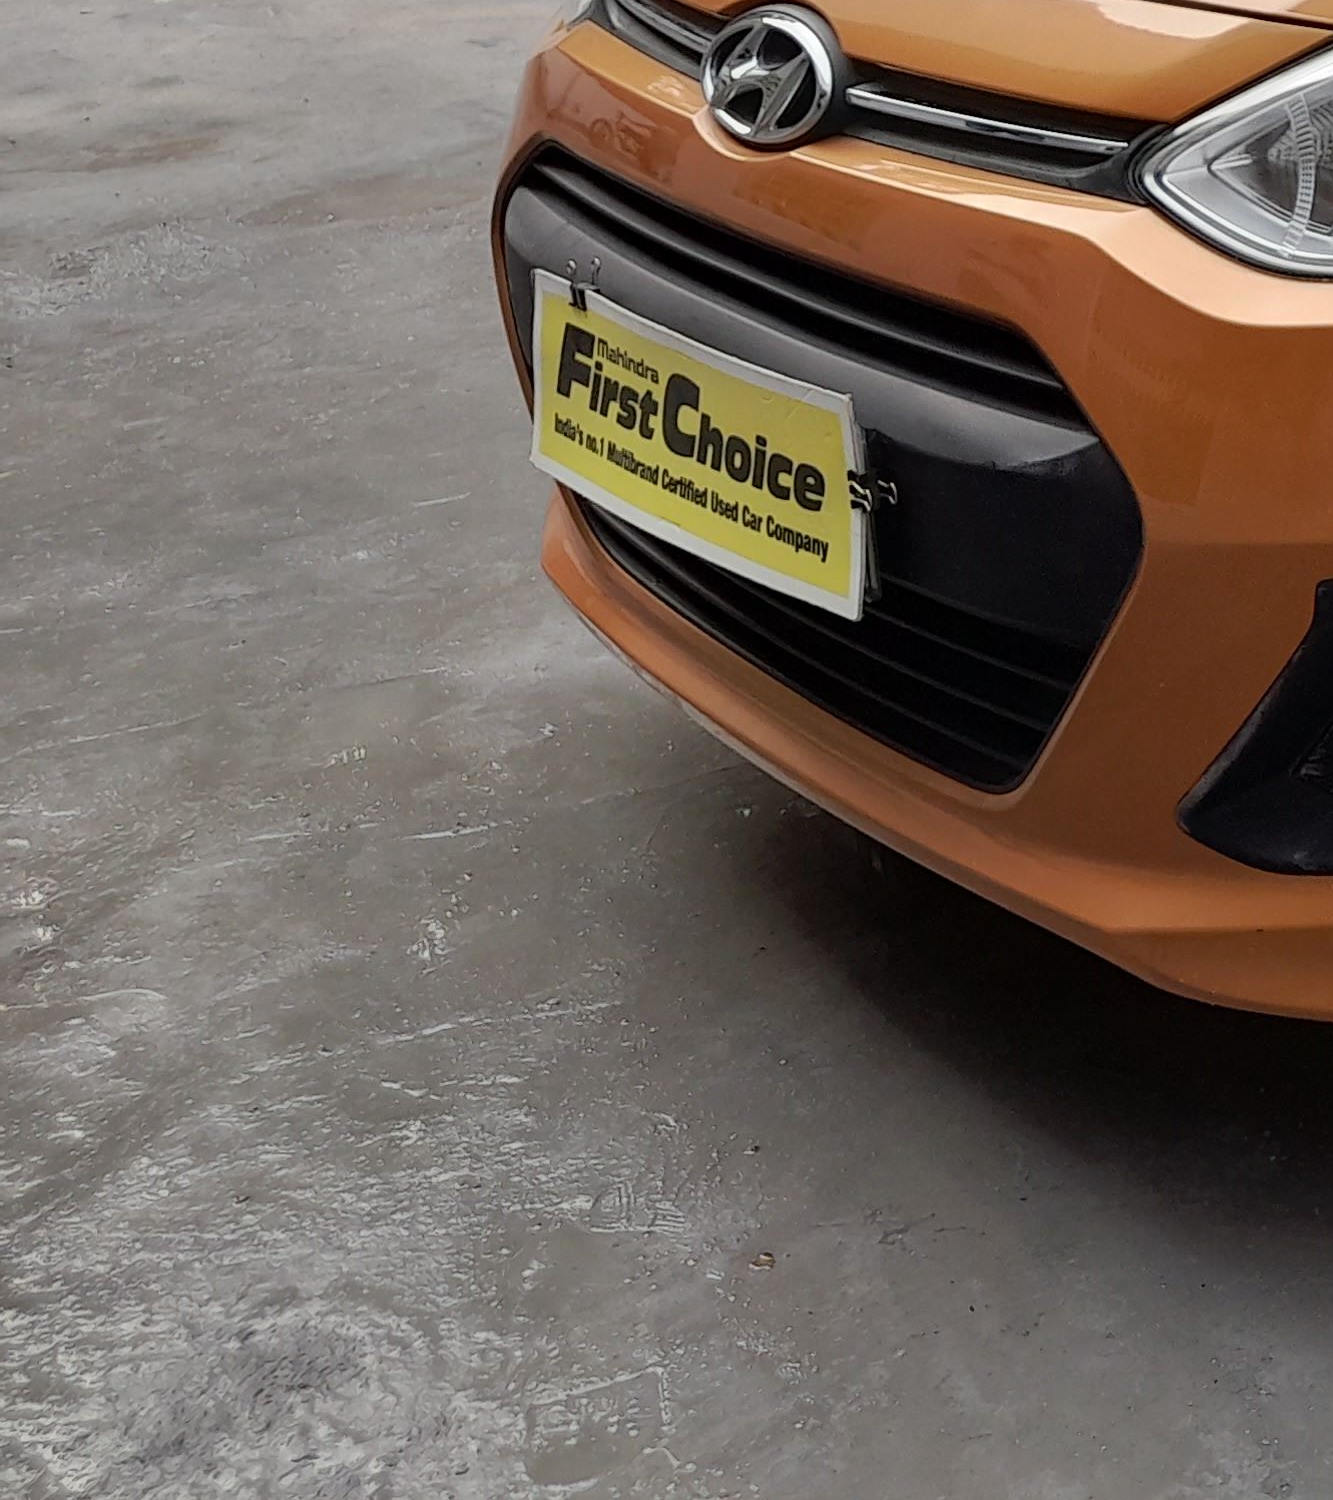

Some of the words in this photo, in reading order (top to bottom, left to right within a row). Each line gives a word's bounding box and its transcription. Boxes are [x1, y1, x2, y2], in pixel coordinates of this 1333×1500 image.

[556, 322, 657, 439] First
[662, 373, 826, 512] Choice
[597, 339, 659, 384] Mahindra
[554, 412, 584, 446] India's
[607, 441, 659, 488] Multibrand
[661, 467, 708, 508] Certified
[711, 493, 738, 523] Used
[742, 504, 762, 532] Car
[766, 515, 829, 563] Company
